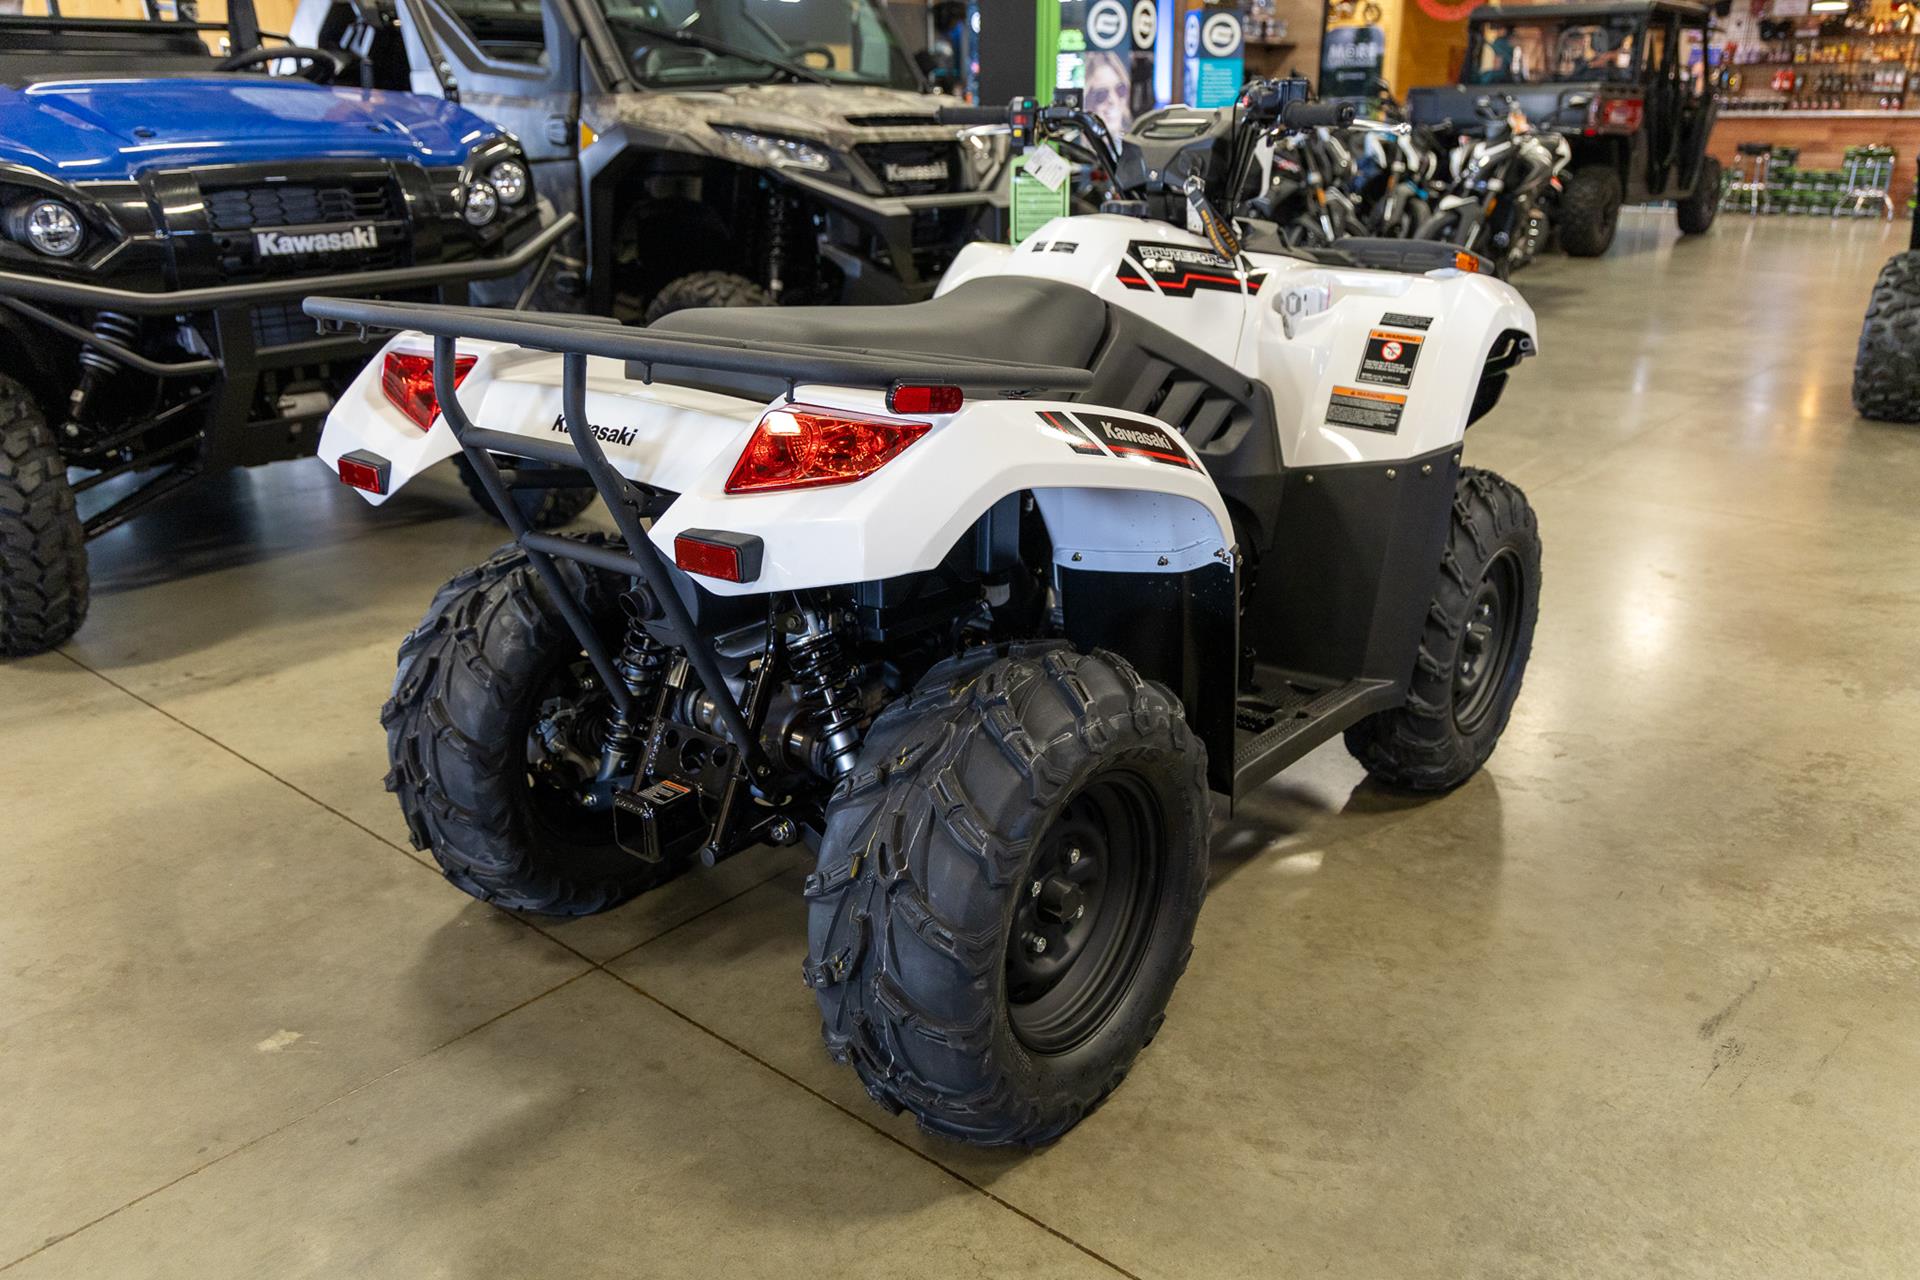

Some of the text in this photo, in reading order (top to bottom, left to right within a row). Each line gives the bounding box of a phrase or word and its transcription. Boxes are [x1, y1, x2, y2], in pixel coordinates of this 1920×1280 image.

[257, 226, 377, 256] Kawasaki
[551, 413, 638, 447] Kasaki
[1100, 421, 1173, 451] Kawasaki
